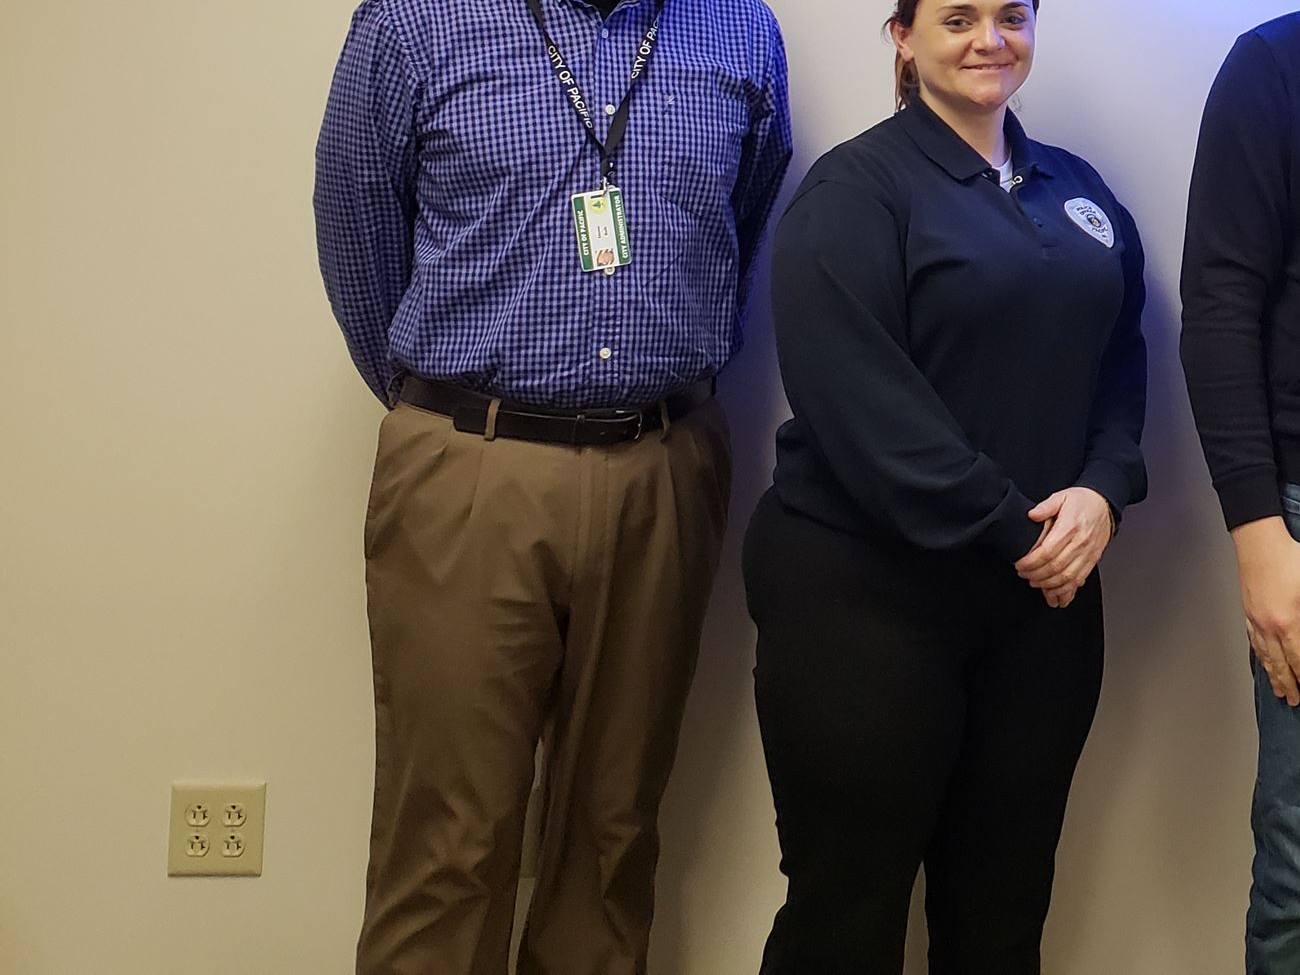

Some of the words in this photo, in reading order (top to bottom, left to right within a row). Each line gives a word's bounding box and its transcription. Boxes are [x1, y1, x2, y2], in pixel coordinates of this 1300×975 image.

[548, 45, 566, 69] CITY
[559, 70, 575, 86] OF
[631, 56, 647, 79] CITY
[640, 40, 652, 55] OF
